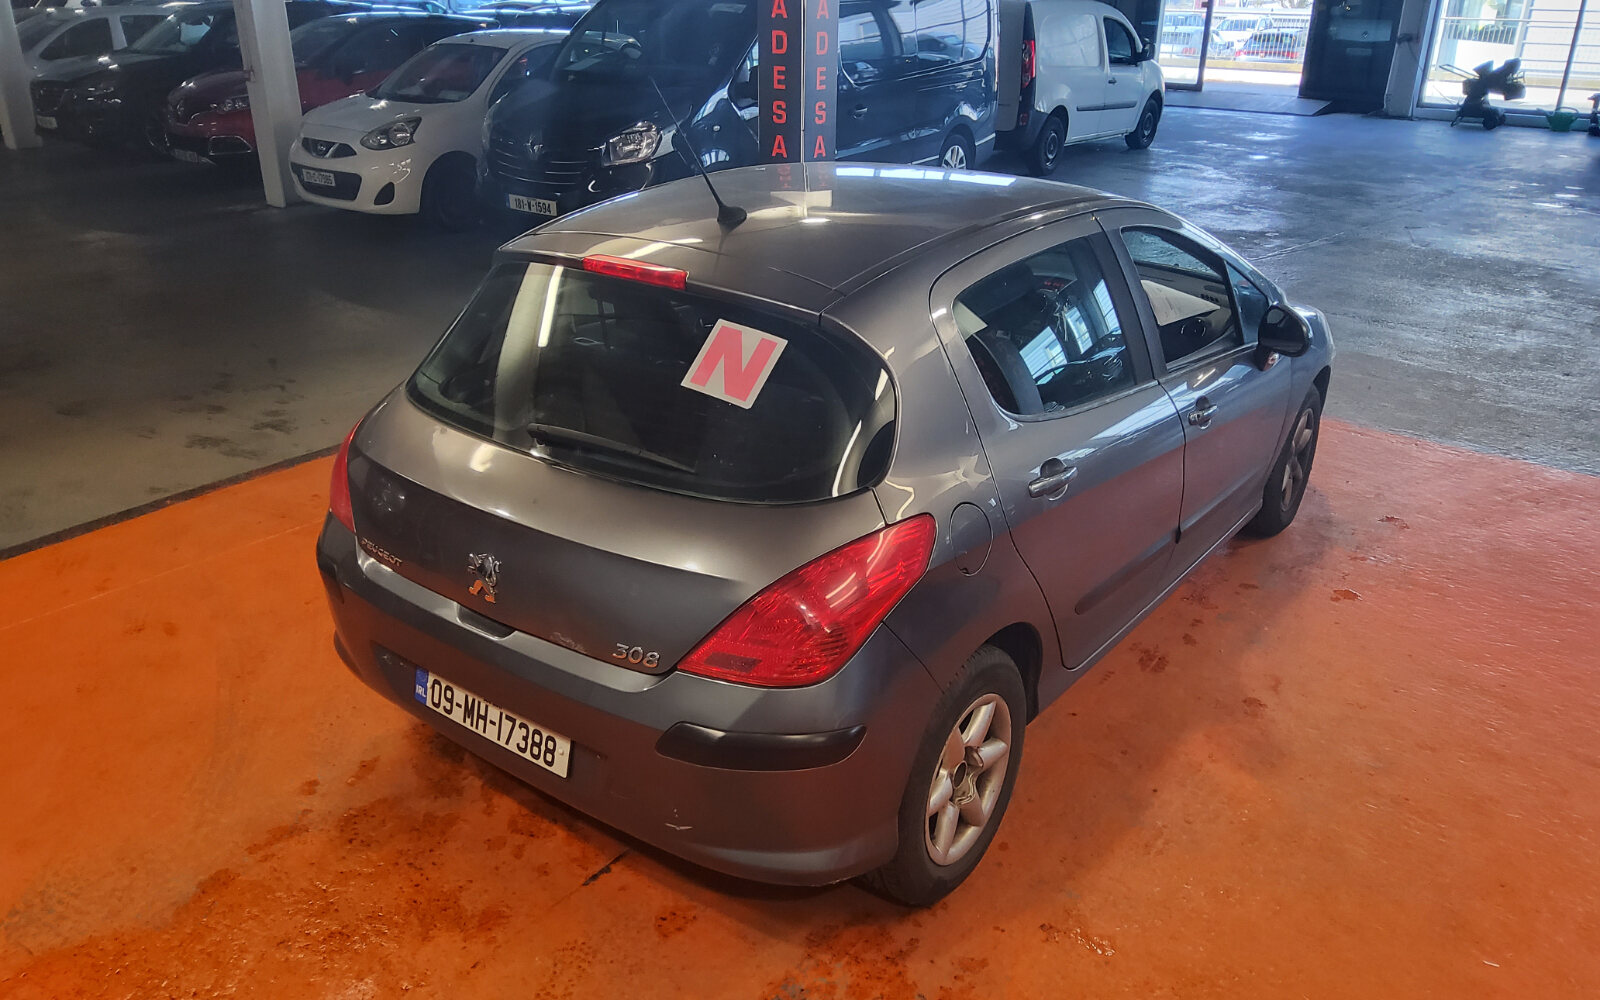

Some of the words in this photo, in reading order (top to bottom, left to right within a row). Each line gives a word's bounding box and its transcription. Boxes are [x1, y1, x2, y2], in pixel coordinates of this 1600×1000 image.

[690, 325, 778, 402] N
[361, 537, 403, 567] PEUGEOT
[612, 643, 660, 668] 308
[415, 684, 427, 698] IRL
[431, 678, 557, 768] 09-MH-17388
